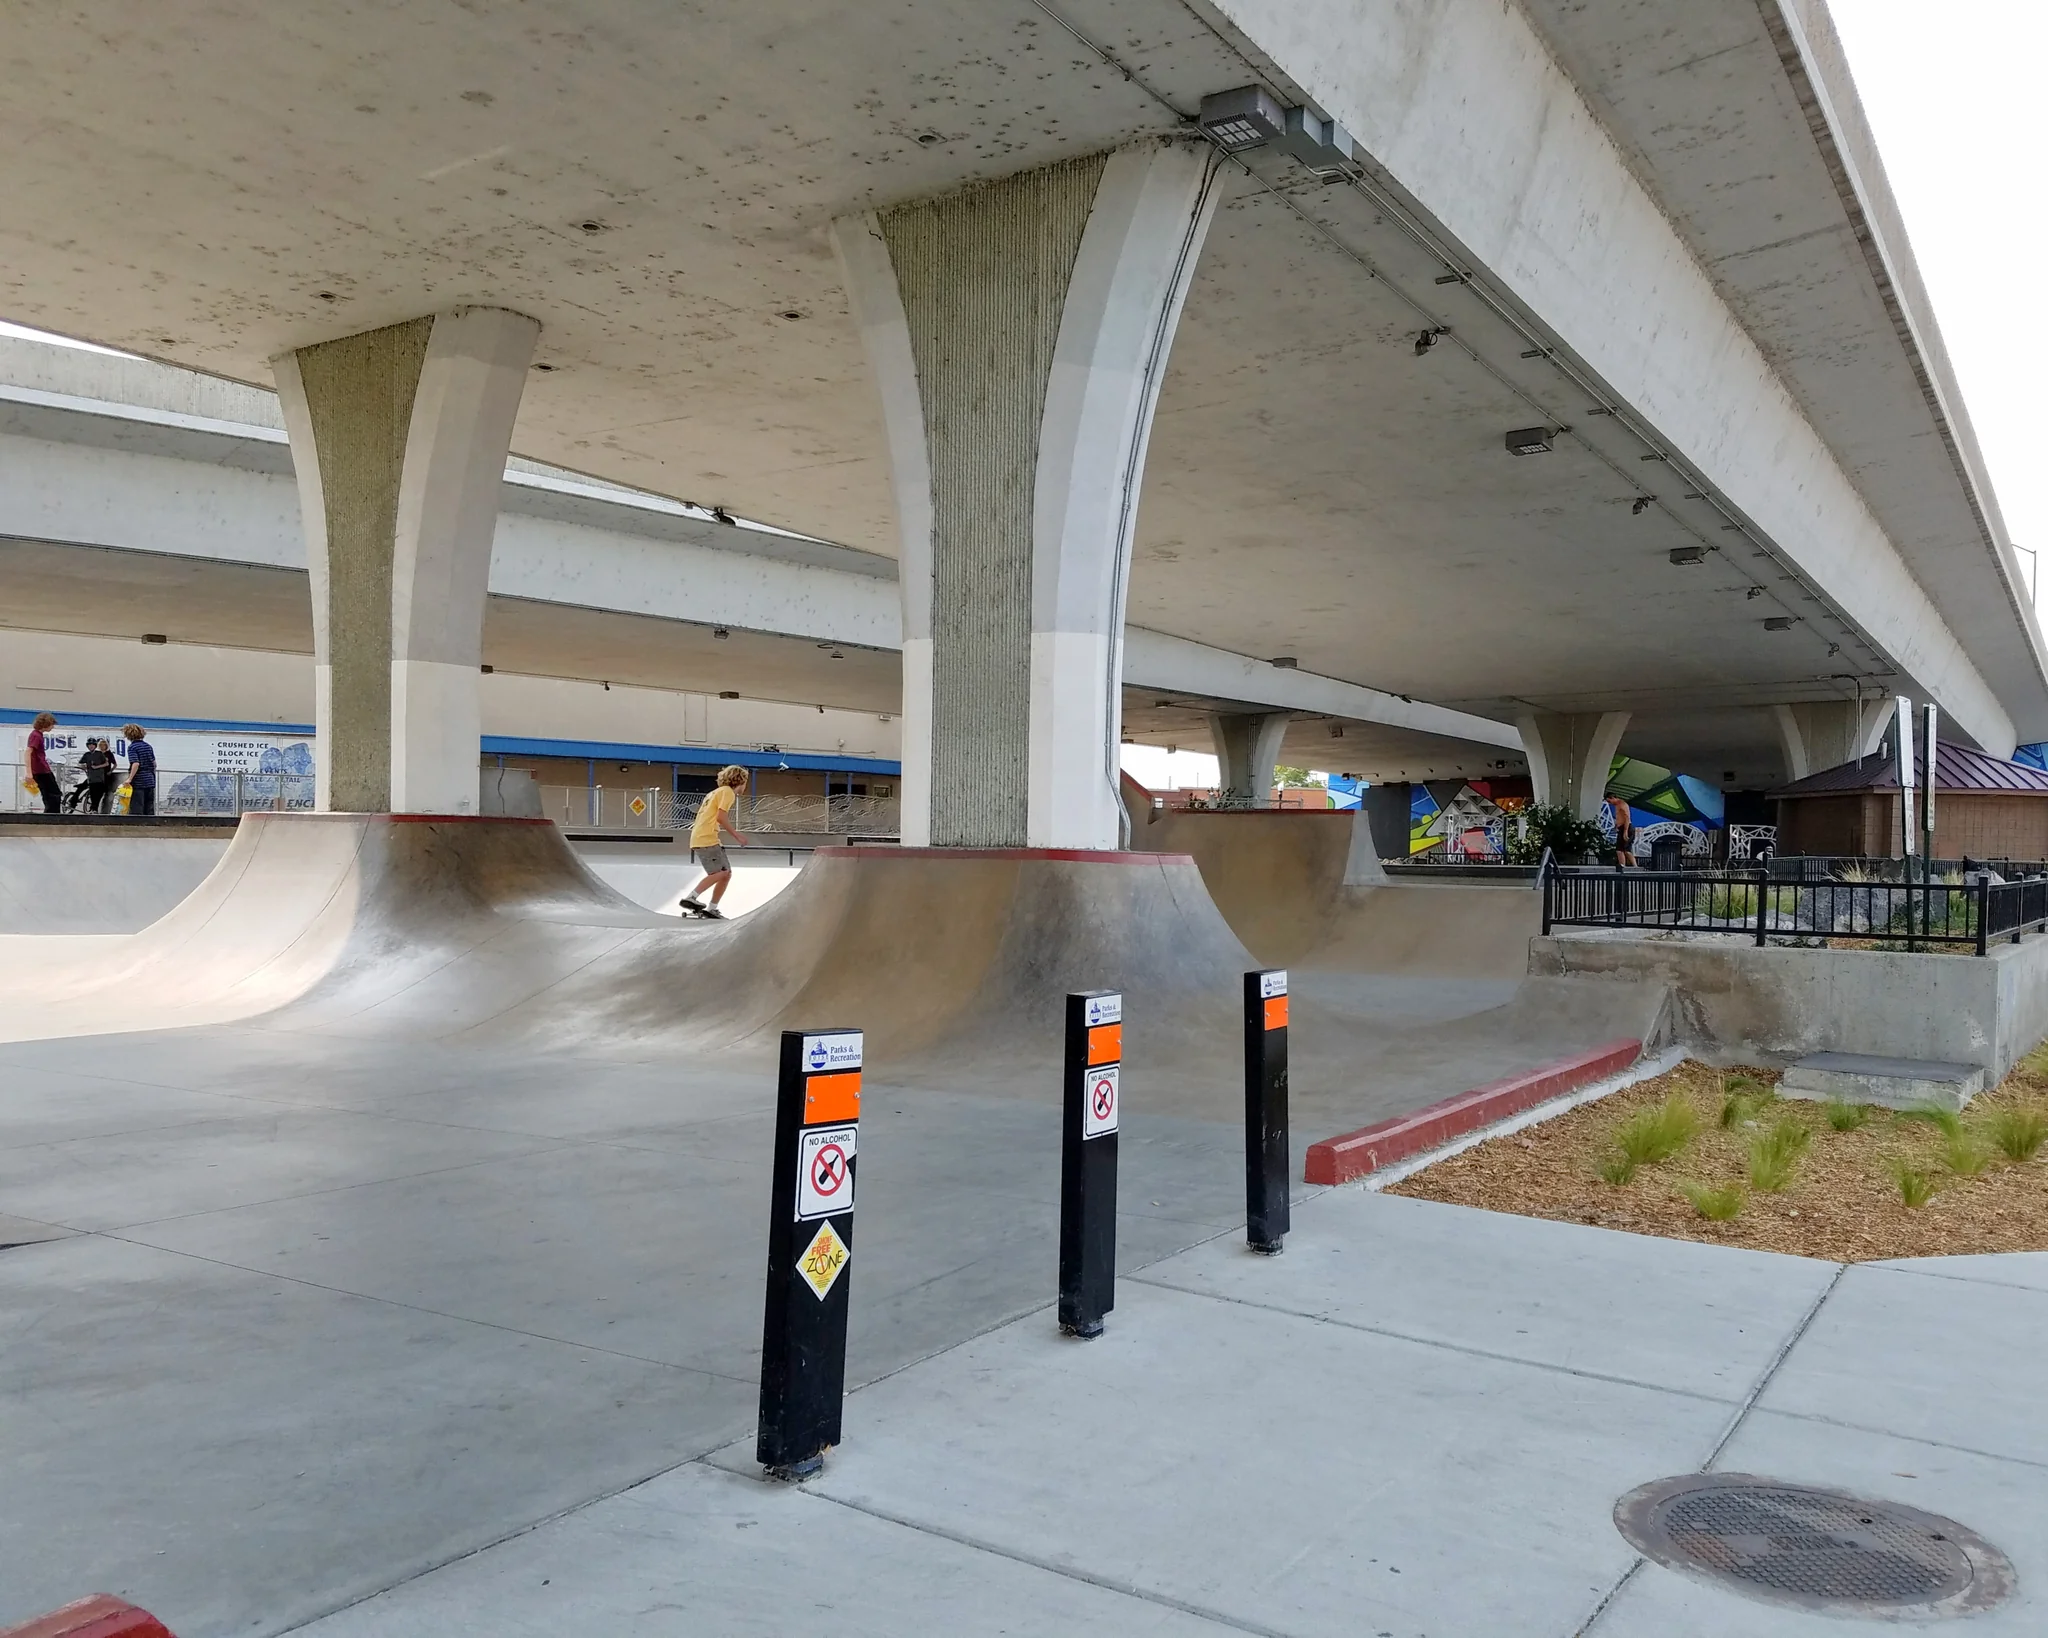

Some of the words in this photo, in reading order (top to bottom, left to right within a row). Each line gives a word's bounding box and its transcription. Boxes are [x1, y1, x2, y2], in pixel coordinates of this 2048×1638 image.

[43, 733, 77, 750] OISE
[167, 797, 203, 807] TASTE
[210, 798, 234, 807] THE
[830, 1045, 847, 1054] Parks
[830, 1053, 861, 1062] Recreation
[809, 1137, 819, 1146] NO
[821, 1134, 851, 1144] ALCOHOL
[812, 1244, 831, 1256] FREE
[807, 1250, 843, 1275] ZONE
